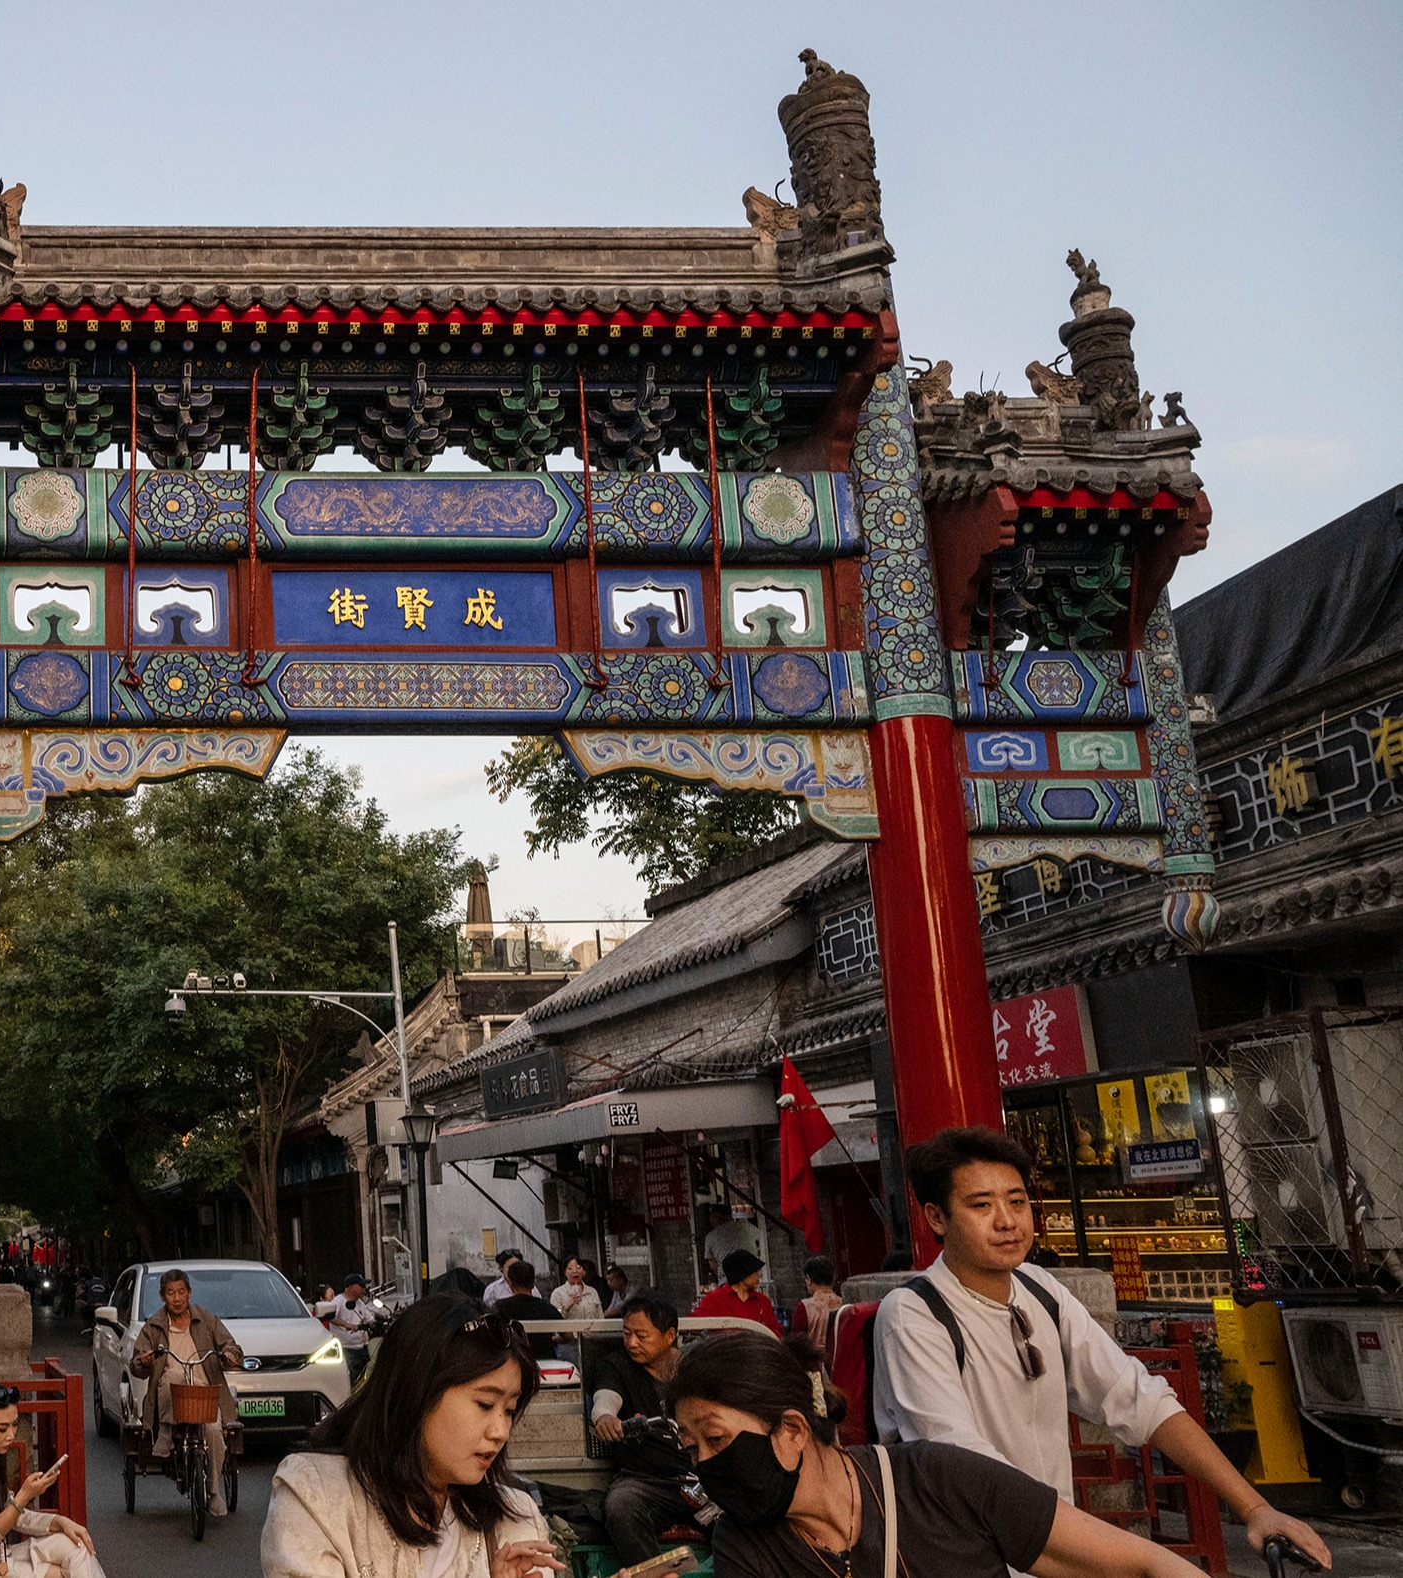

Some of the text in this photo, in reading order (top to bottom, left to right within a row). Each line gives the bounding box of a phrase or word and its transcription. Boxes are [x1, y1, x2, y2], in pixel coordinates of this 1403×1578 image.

[610, 1104, 637, 1115] FRYZ
[612, 1114, 638, 1125] FRYZ
[1360, 1337, 1377, 1345] TCL
[244, 1400, 284, 1413] DR5036
